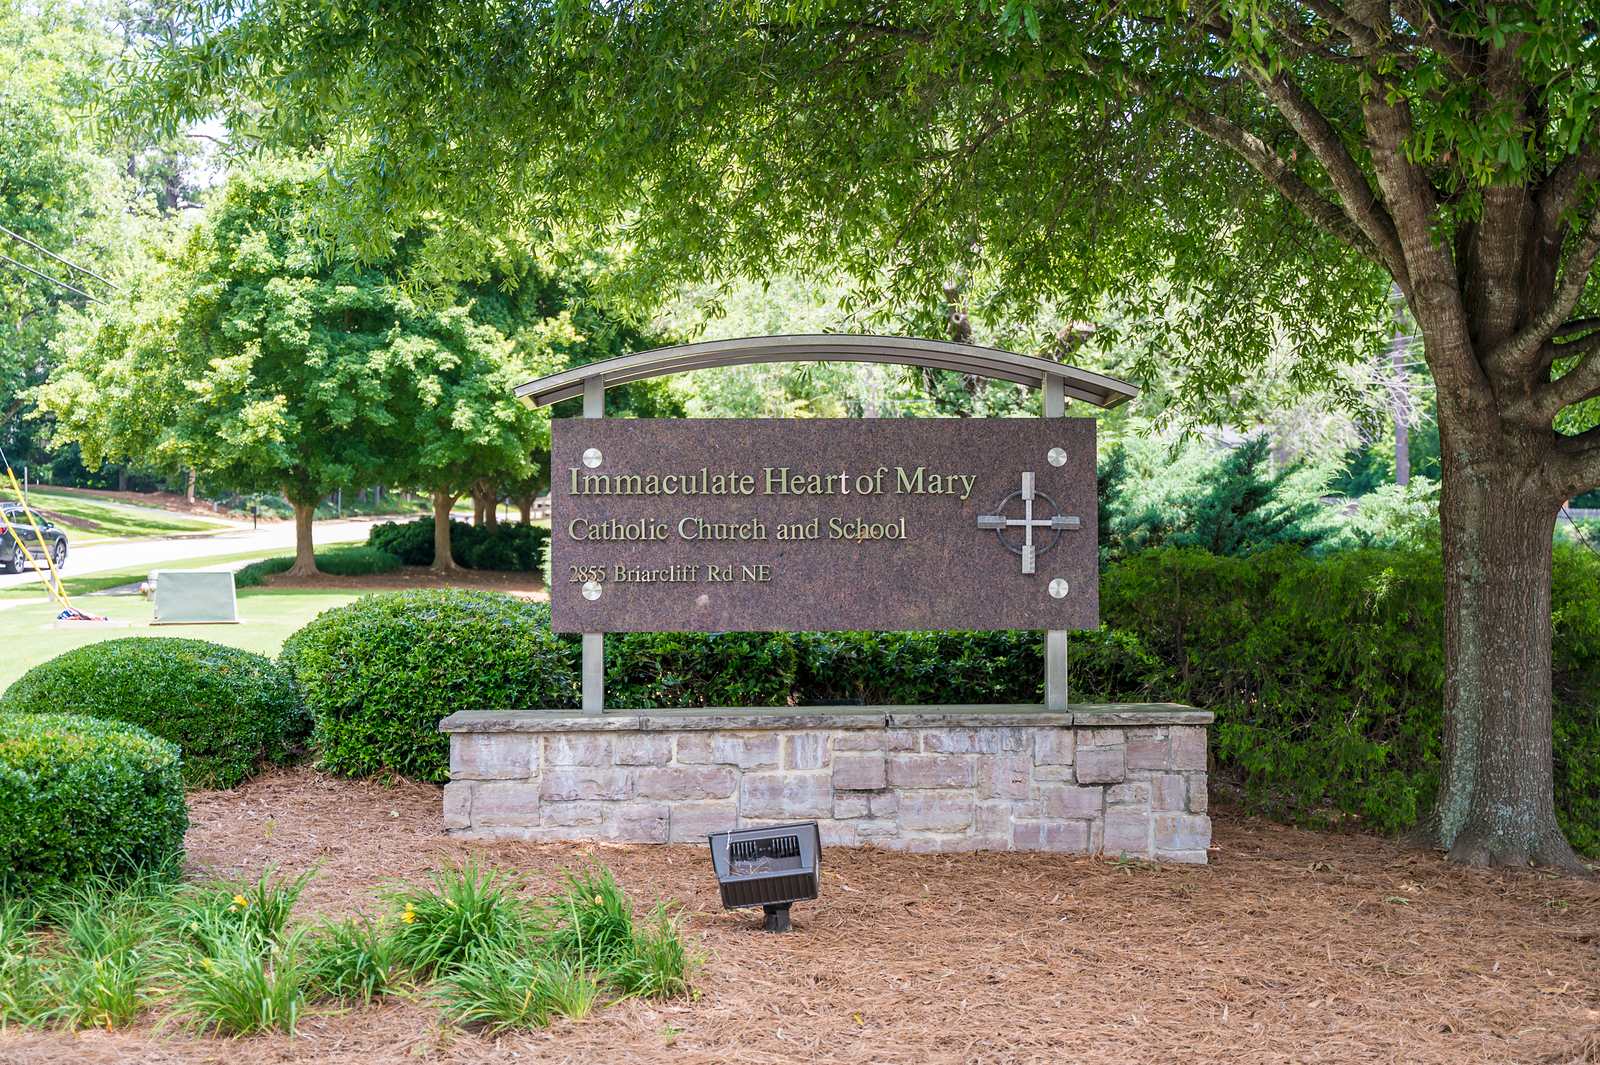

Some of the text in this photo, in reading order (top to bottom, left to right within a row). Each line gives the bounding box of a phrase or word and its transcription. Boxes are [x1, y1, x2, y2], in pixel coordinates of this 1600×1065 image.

[568, 467, 977, 500] Immaculate Heart of Mary
[568, 517, 908, 541] Catholic Church and School
[568, 564, 771, 582] 2855 Briarcliff Rd NE
